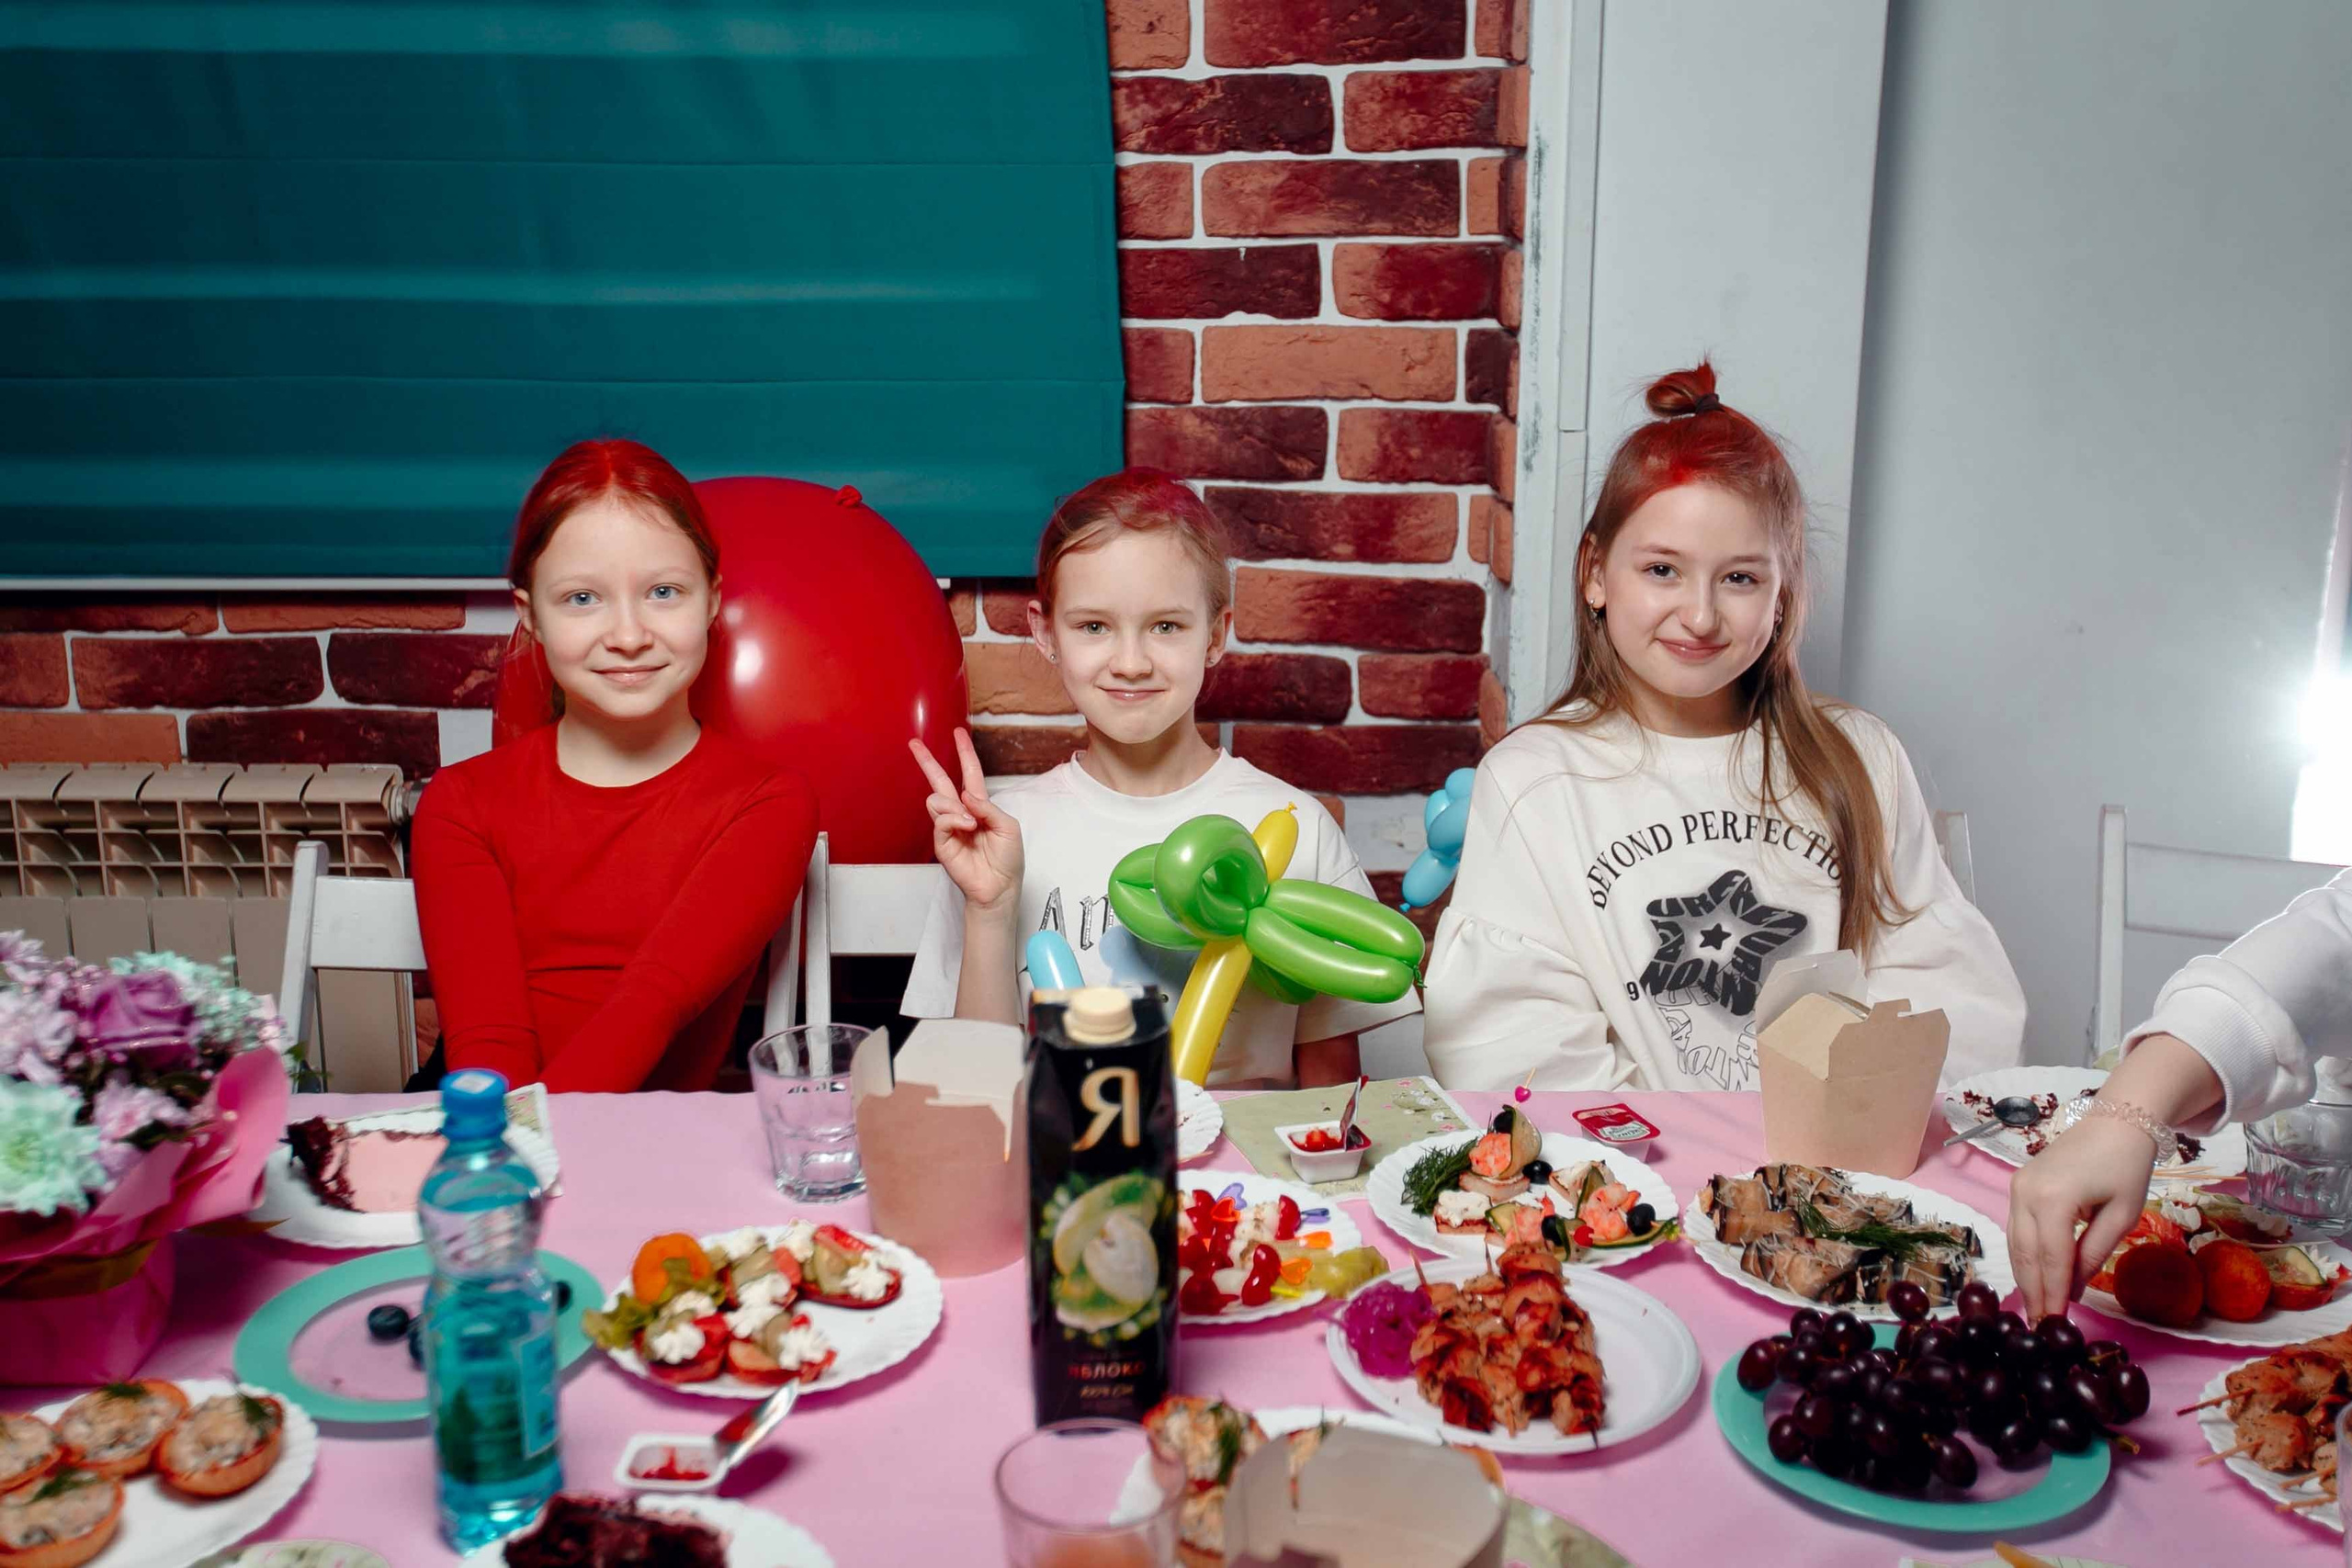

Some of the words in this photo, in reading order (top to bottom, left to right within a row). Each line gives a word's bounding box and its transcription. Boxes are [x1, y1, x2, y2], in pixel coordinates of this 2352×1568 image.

[1587, 823, 1673, 910] BEYOND
[1680, 810, 1841, 881] PERFECTIO
[1071, 1066, 1140, 1152] Я
